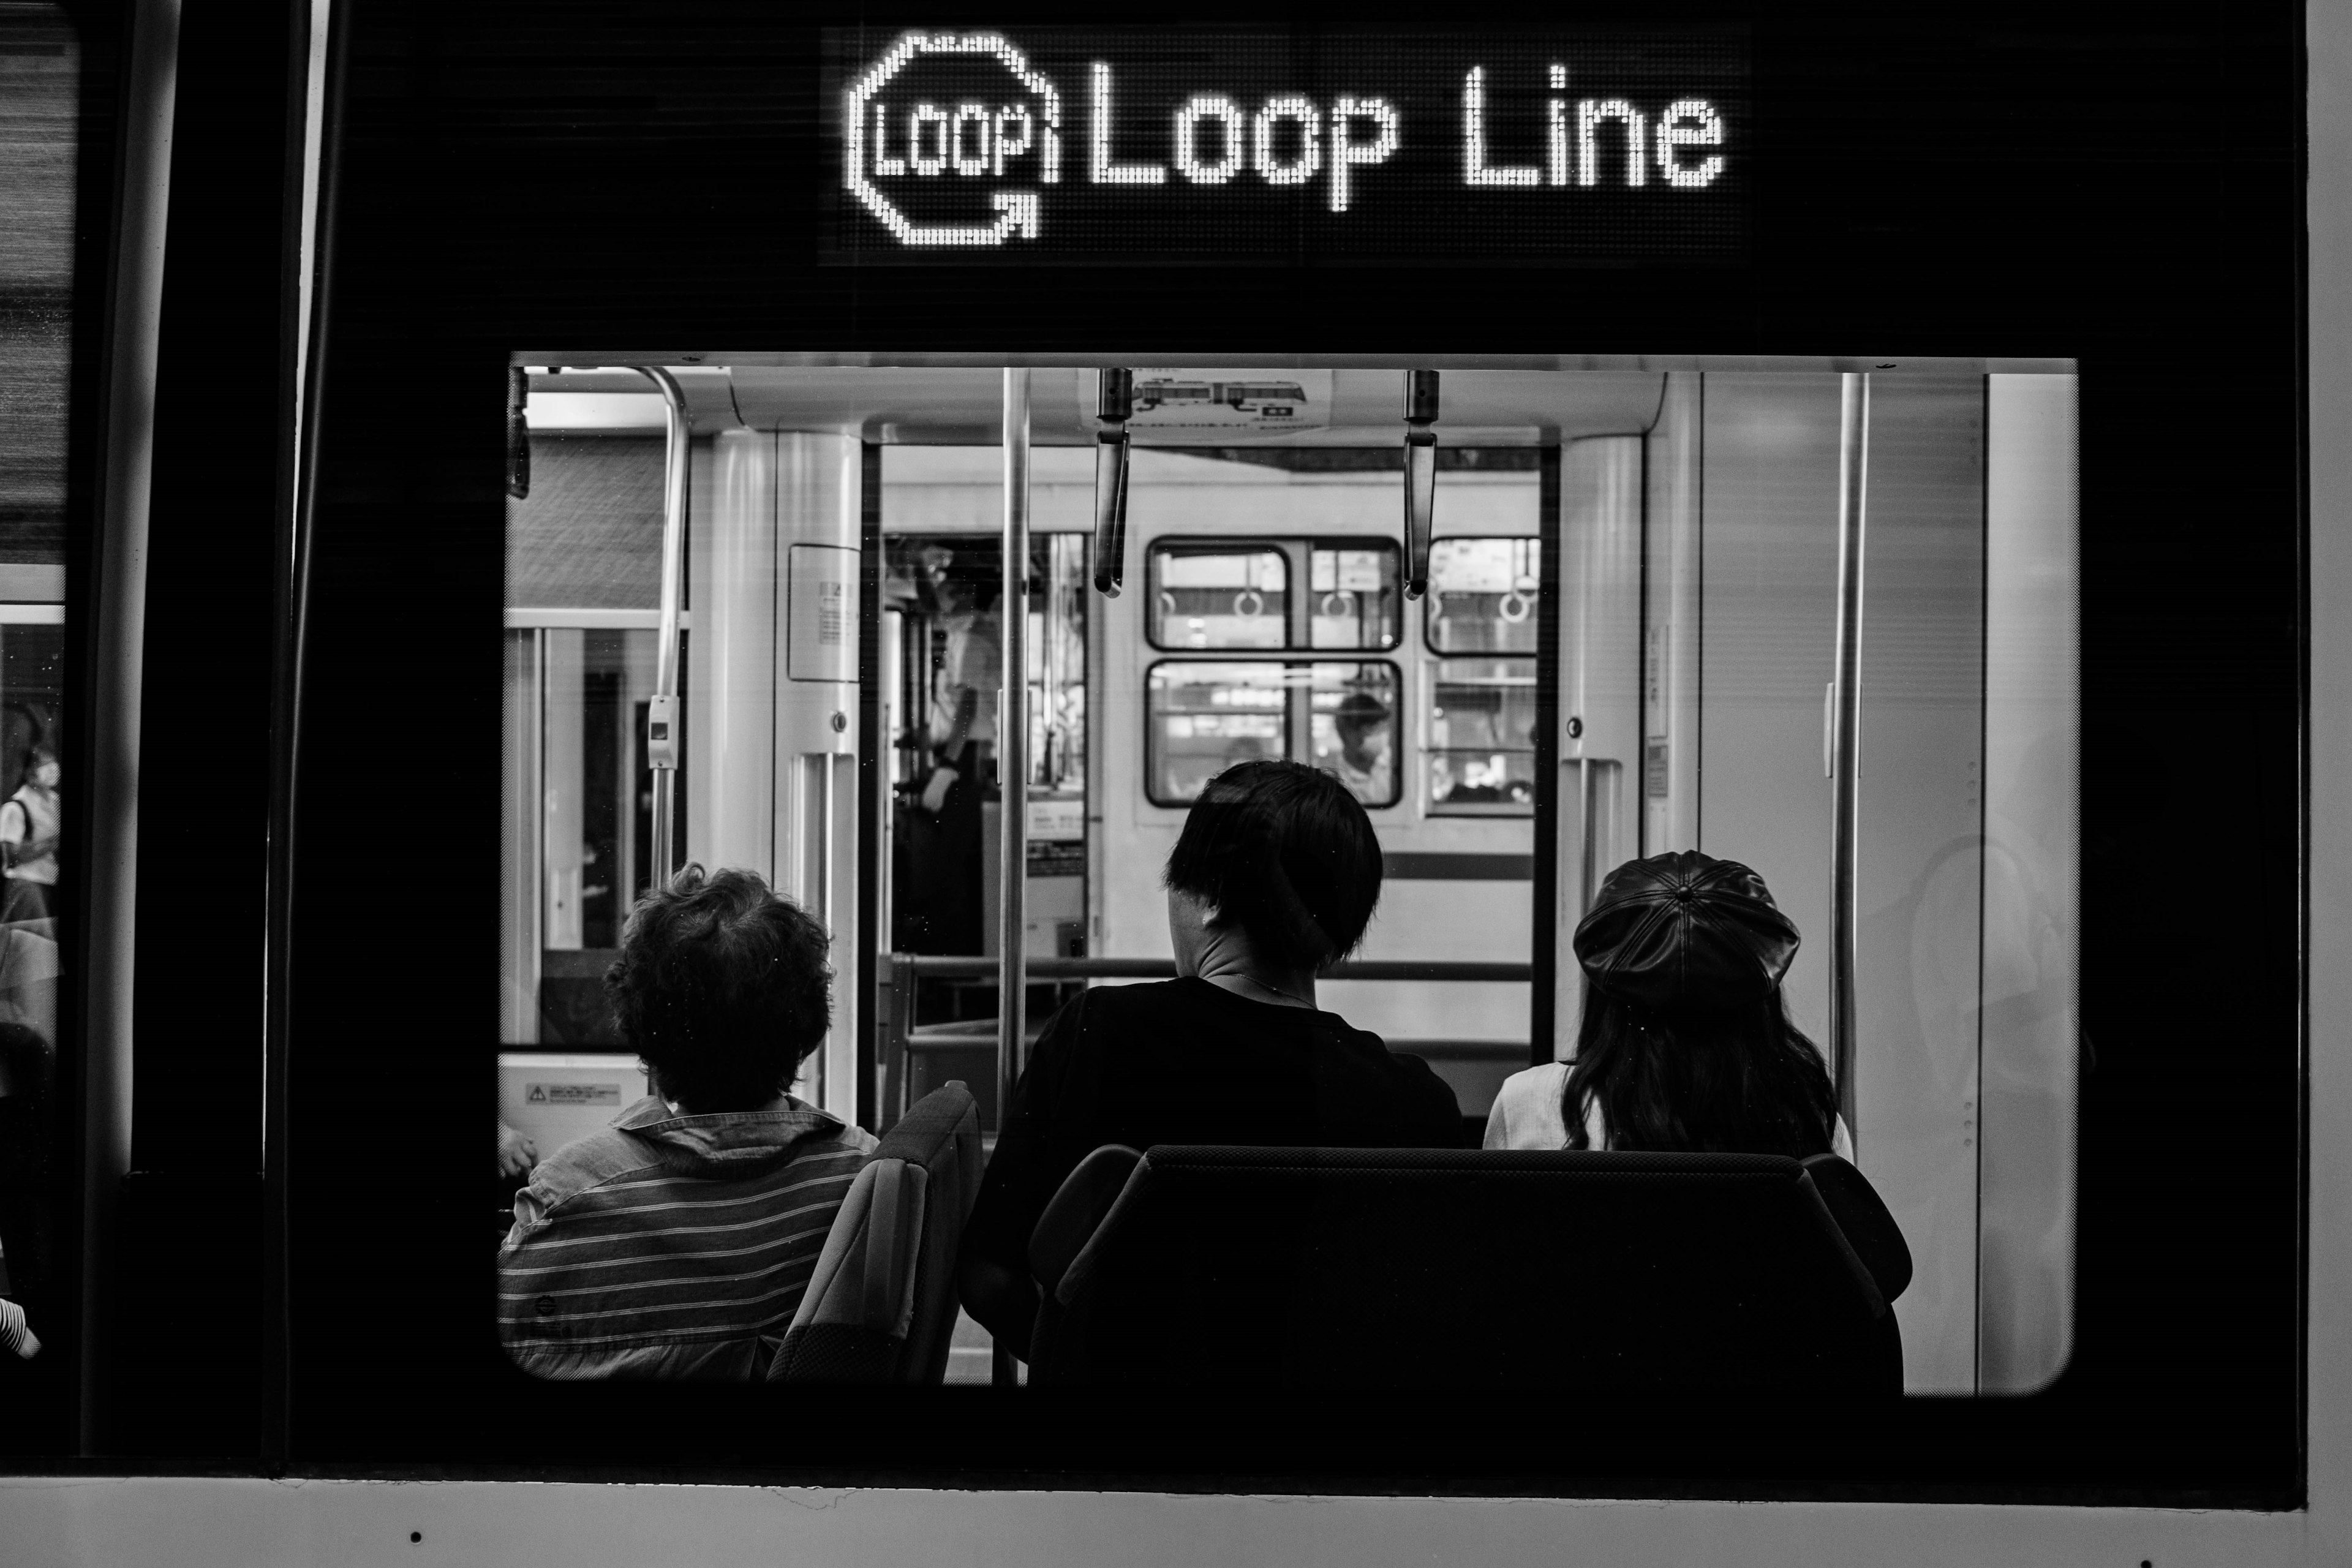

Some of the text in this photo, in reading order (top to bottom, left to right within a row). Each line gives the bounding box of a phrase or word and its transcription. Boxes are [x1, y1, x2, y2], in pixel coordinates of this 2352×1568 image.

[876, 104, 1031, 176] LOOP
[1089, 62, 1724, 212] Loop Line
